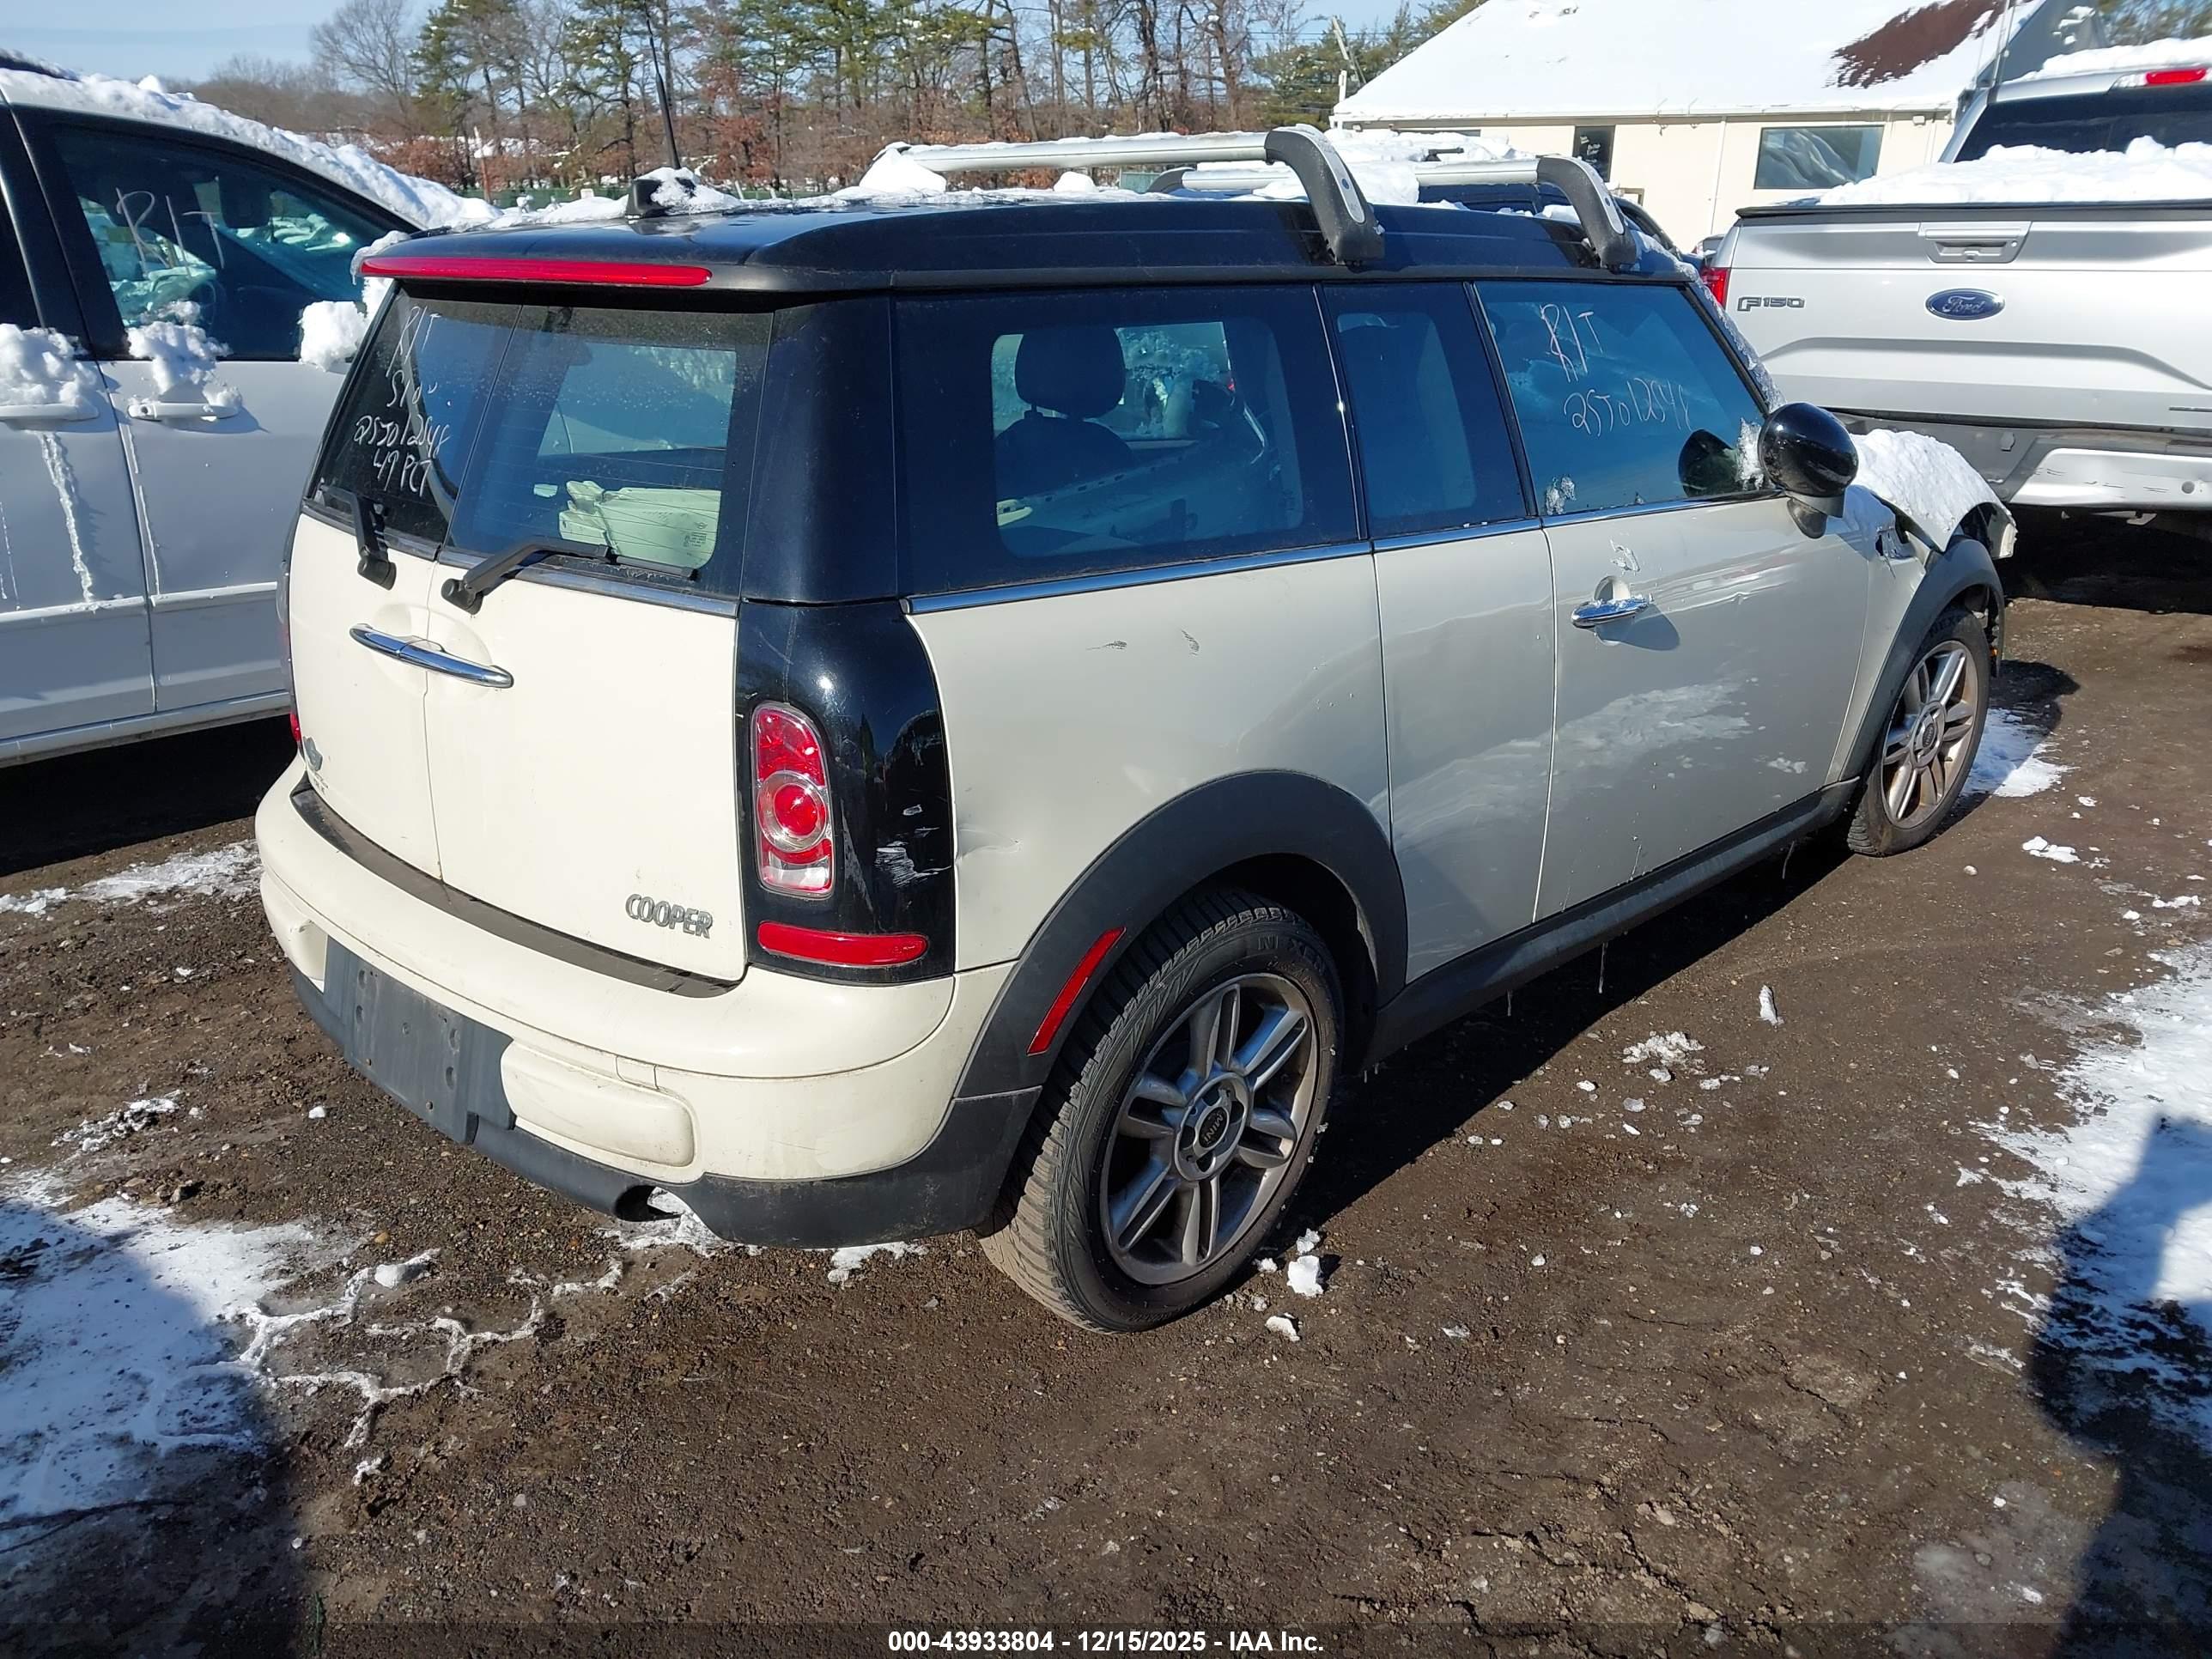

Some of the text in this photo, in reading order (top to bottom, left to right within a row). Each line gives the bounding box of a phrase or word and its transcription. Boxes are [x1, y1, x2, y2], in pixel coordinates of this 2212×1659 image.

[1942, 295, 1986, 314] Ford
[624, 893, 714, 939] COOPER
[1203, 1113, 1224, 1144] MINI
